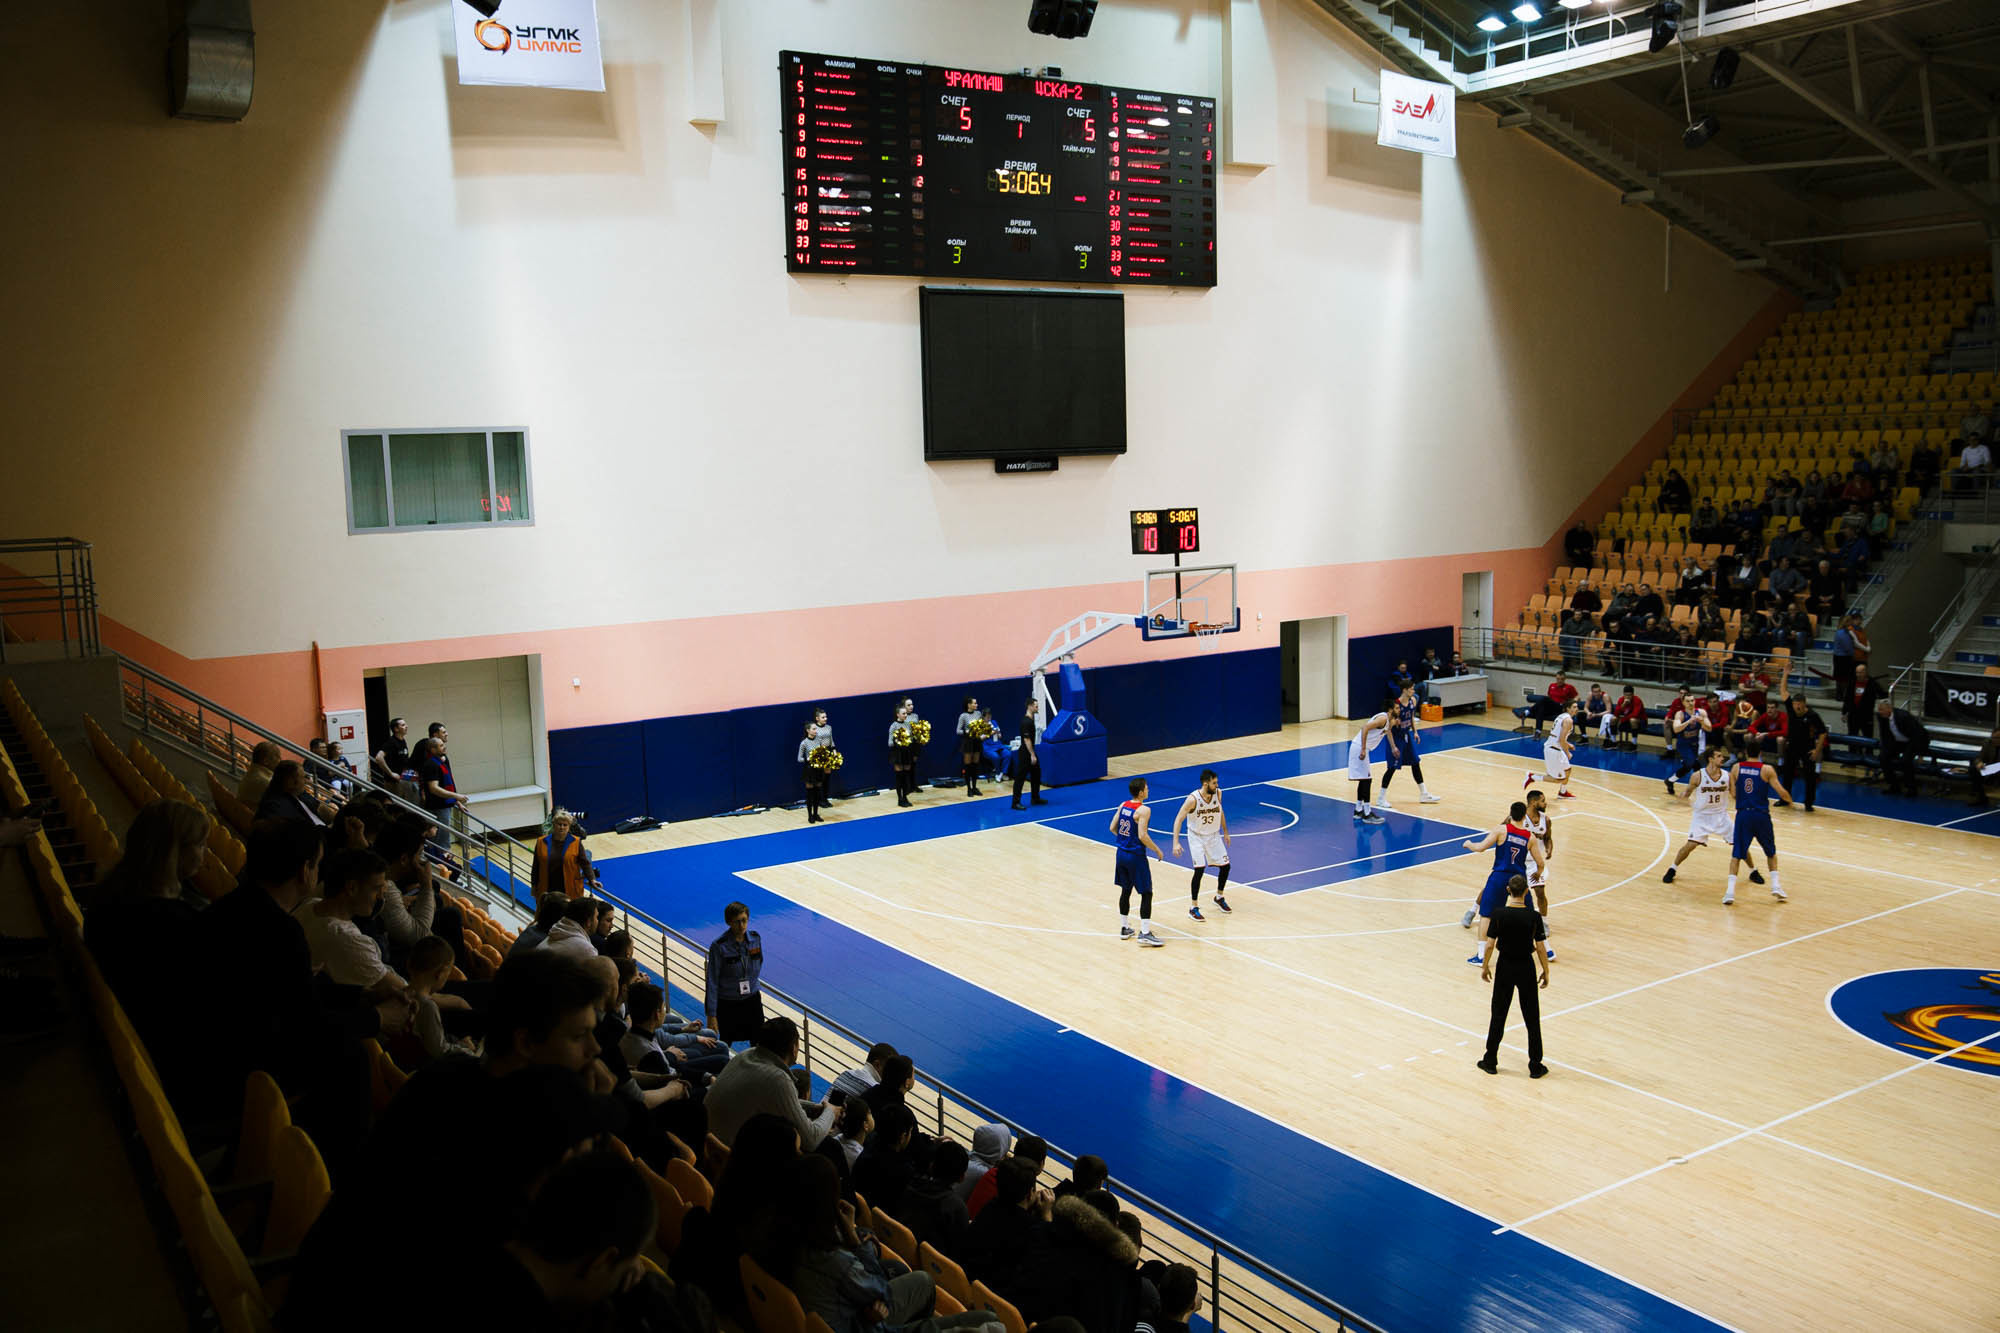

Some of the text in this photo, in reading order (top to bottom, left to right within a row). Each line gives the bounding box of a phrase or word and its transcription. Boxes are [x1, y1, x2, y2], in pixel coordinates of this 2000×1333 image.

[516, 25, 581, 41] УГМК
[517, 39, 582, 54] UMMC
[800, 64, 804, 76] 1
[825, 60, 855, 69] ФАМИЛИЯ
[877, 65, 896, 73] ФОЛЫ
[906, 68, 922, 76] ОЧКИ
[797, 80, 804, 92] 5
[945, 70, 1003, 92] УРАЛМАШ
[1035, 80, 1083, 100] ЦСКА-2
[800, 97, 805, 108] 7
[941, 95, 967, 106] СЧЕТ
[1112, 97, 1118, 109] 5
[797, 113, 805, 125] 8
[960, 106, 972, 130] 5
[1006, 113, 1031, 123] ПЕРИОД
[1066, 107, 1091, 119] СЧЕТ
[799, 130, 805, 142] 9
[1018, 122, 1023, 139] 1
[1084, 118, 1096, 142] 5
[937, 134, 973, 144] ТАЙМ-АУТЫ
[1062, 144, 1096, 154] ТАЙМ-АУТЫ
[796, 146, 806, 158] 10
[916, 155, 923, 167] 3
[1004, 160, 1038, 172] ВРЕМЯ
[797, 168, 806, 180] 15
[797, 185, 807, 196] 17
[1109, 189, 1120, 201] 21
[798, 202, 808, 214] 18
[1109, 205, 1120, 217] 22
[796, 219, 808, 231] 30
[1010, 219, 1031, 227] ВРЕМЯ
[1110, 220, 1120, 232] 30
[1004, 226, 1037, 235] ТАЙМ-АУТА
[796, 235, 809, 248] 33
[1110, 235, 1121, 247] 32
[796, 253, 810, 265] 41
[953, 246, 962, 264] 3
[1080, 252, 1088, 269] 3
[1111, 250, 1121, 262] 33
[1110, 265, 1122, 277] 42
[1144, 527, 1157, 552] 10
[1180, 525, 1196, 550] 10
[1947, 688, 1988, 707] РФБ
[1744, 778, 1753, 793] 8
[1202, 816, 1214, 825] 33
[1120, 818, 1131, 837] 22
[1511, 847, 1520, 865] 7
